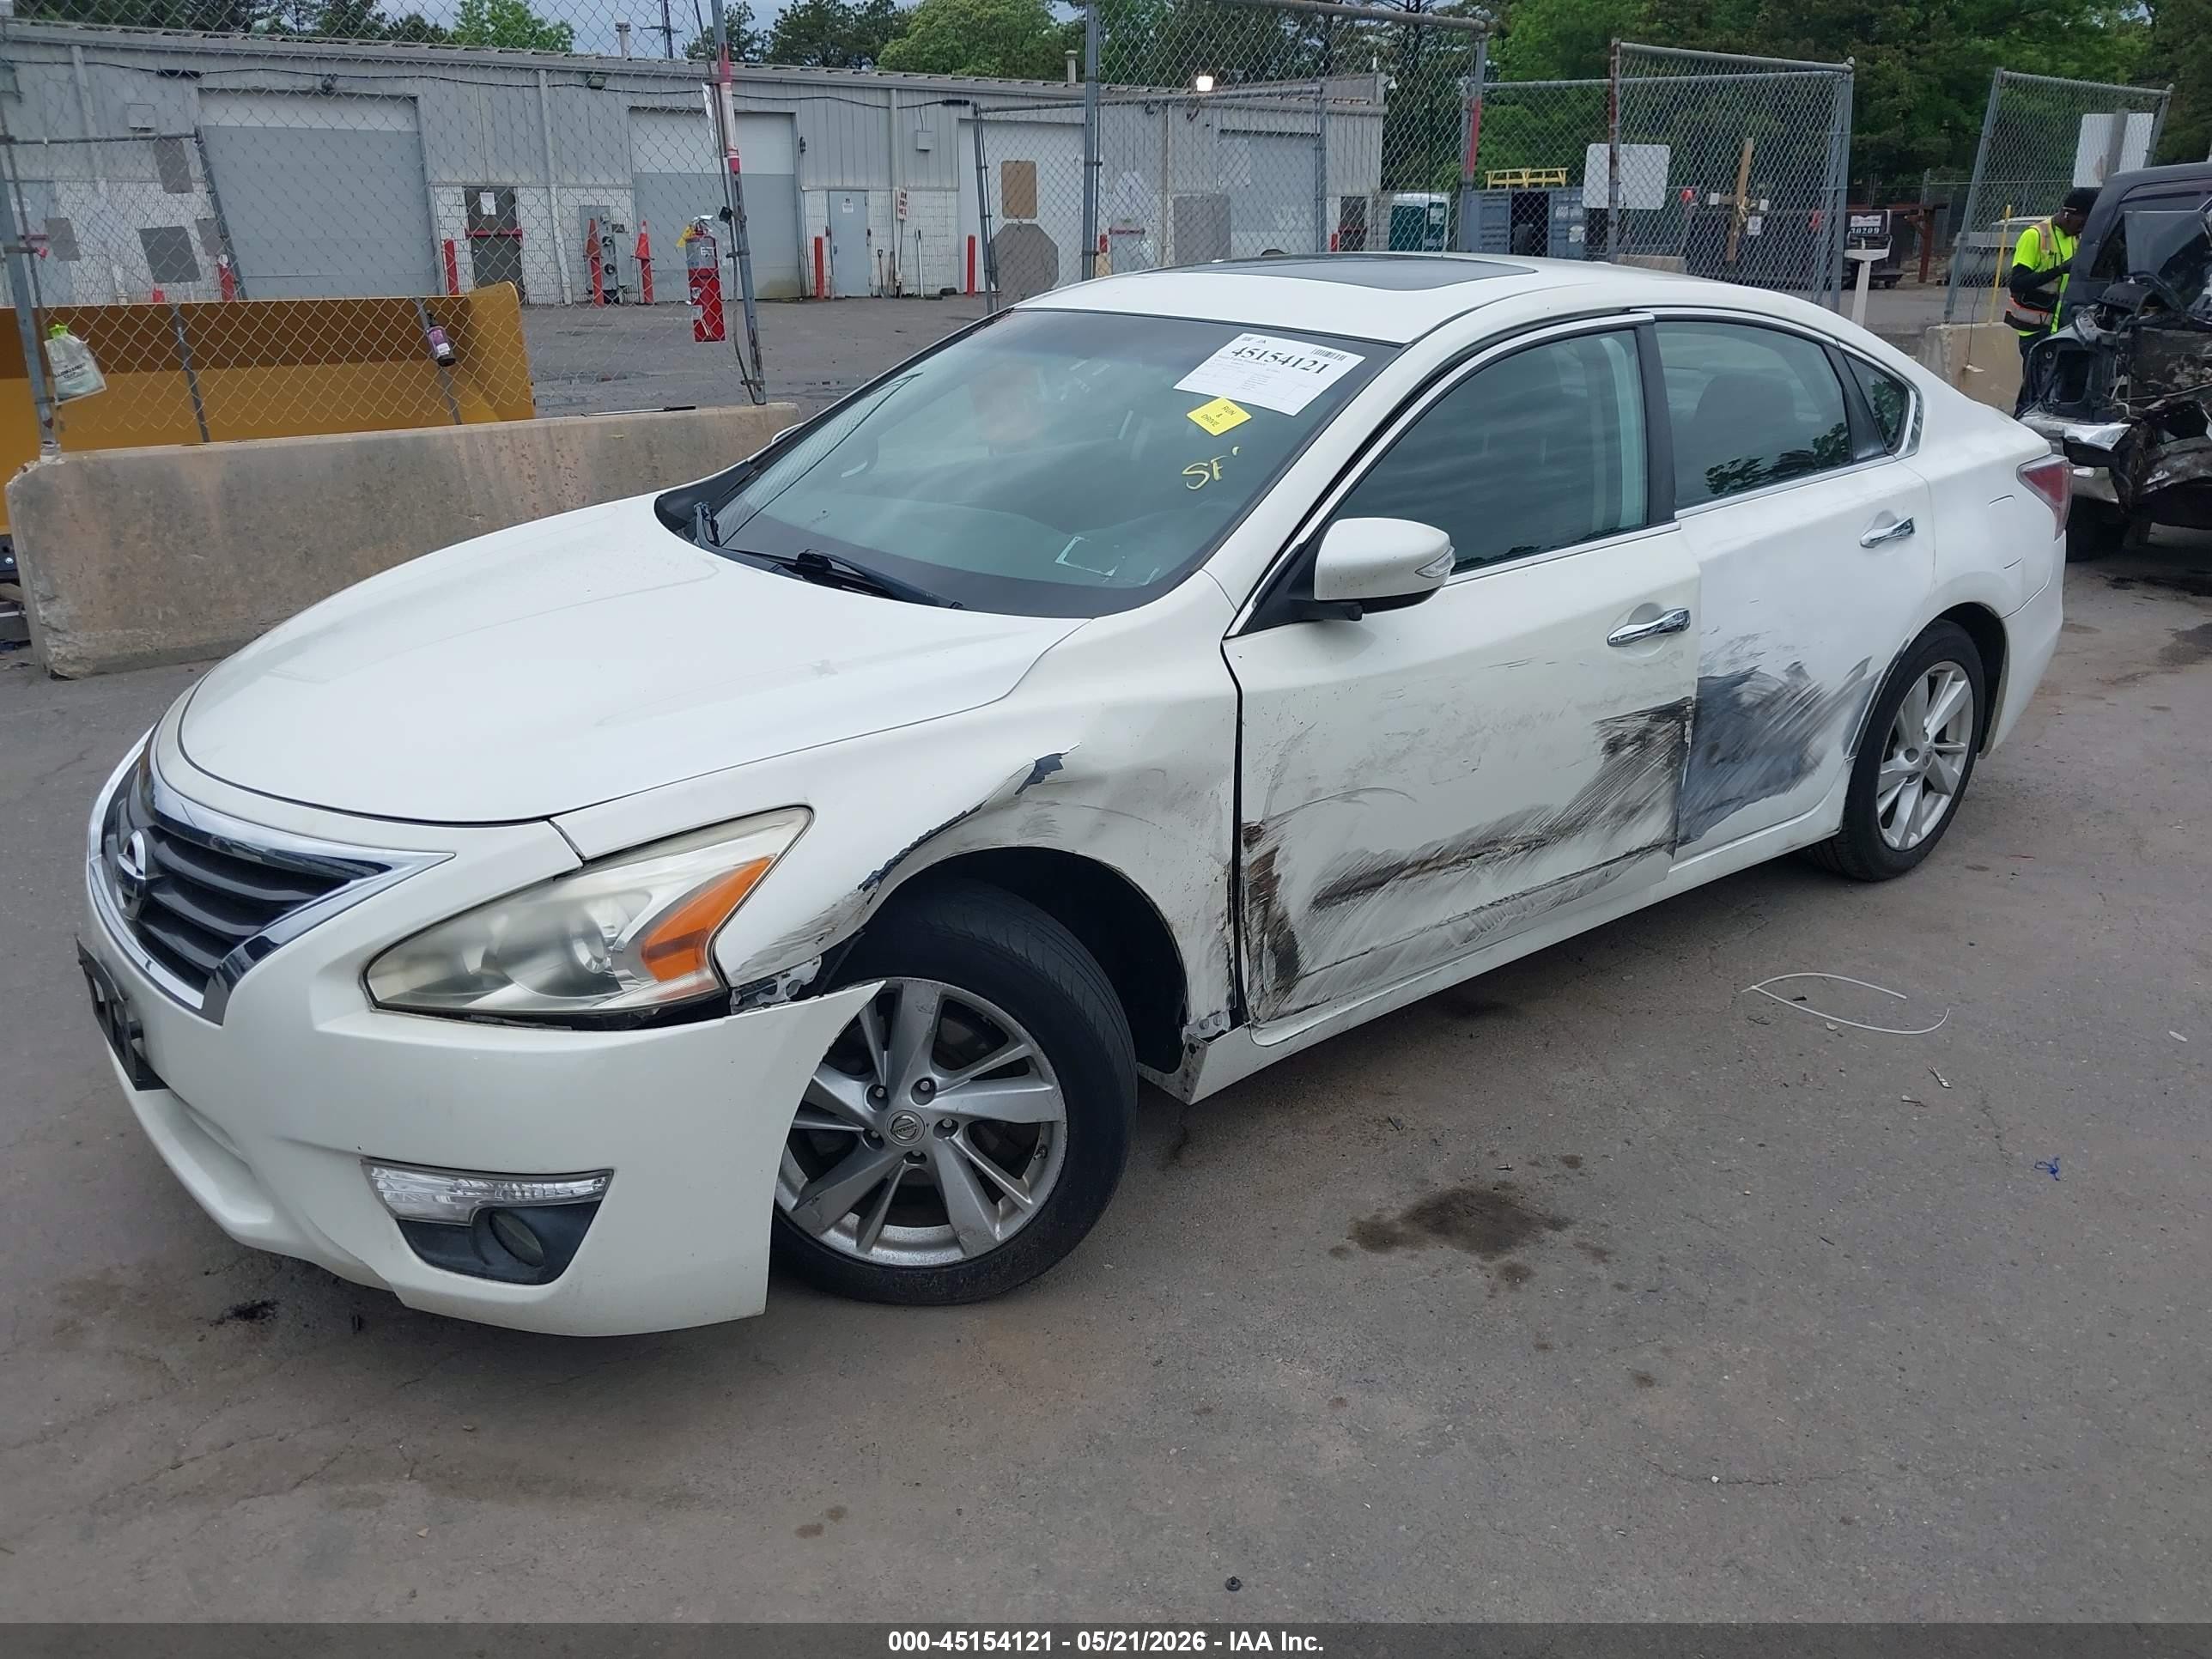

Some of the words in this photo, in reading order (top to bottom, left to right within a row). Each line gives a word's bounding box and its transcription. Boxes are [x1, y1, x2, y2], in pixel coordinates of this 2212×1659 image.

[1231, 346, 1330, 374] 45154121
[1222, 405, 1237, 416] RUN
[1200, 413, 1220, 428] DRIVE
